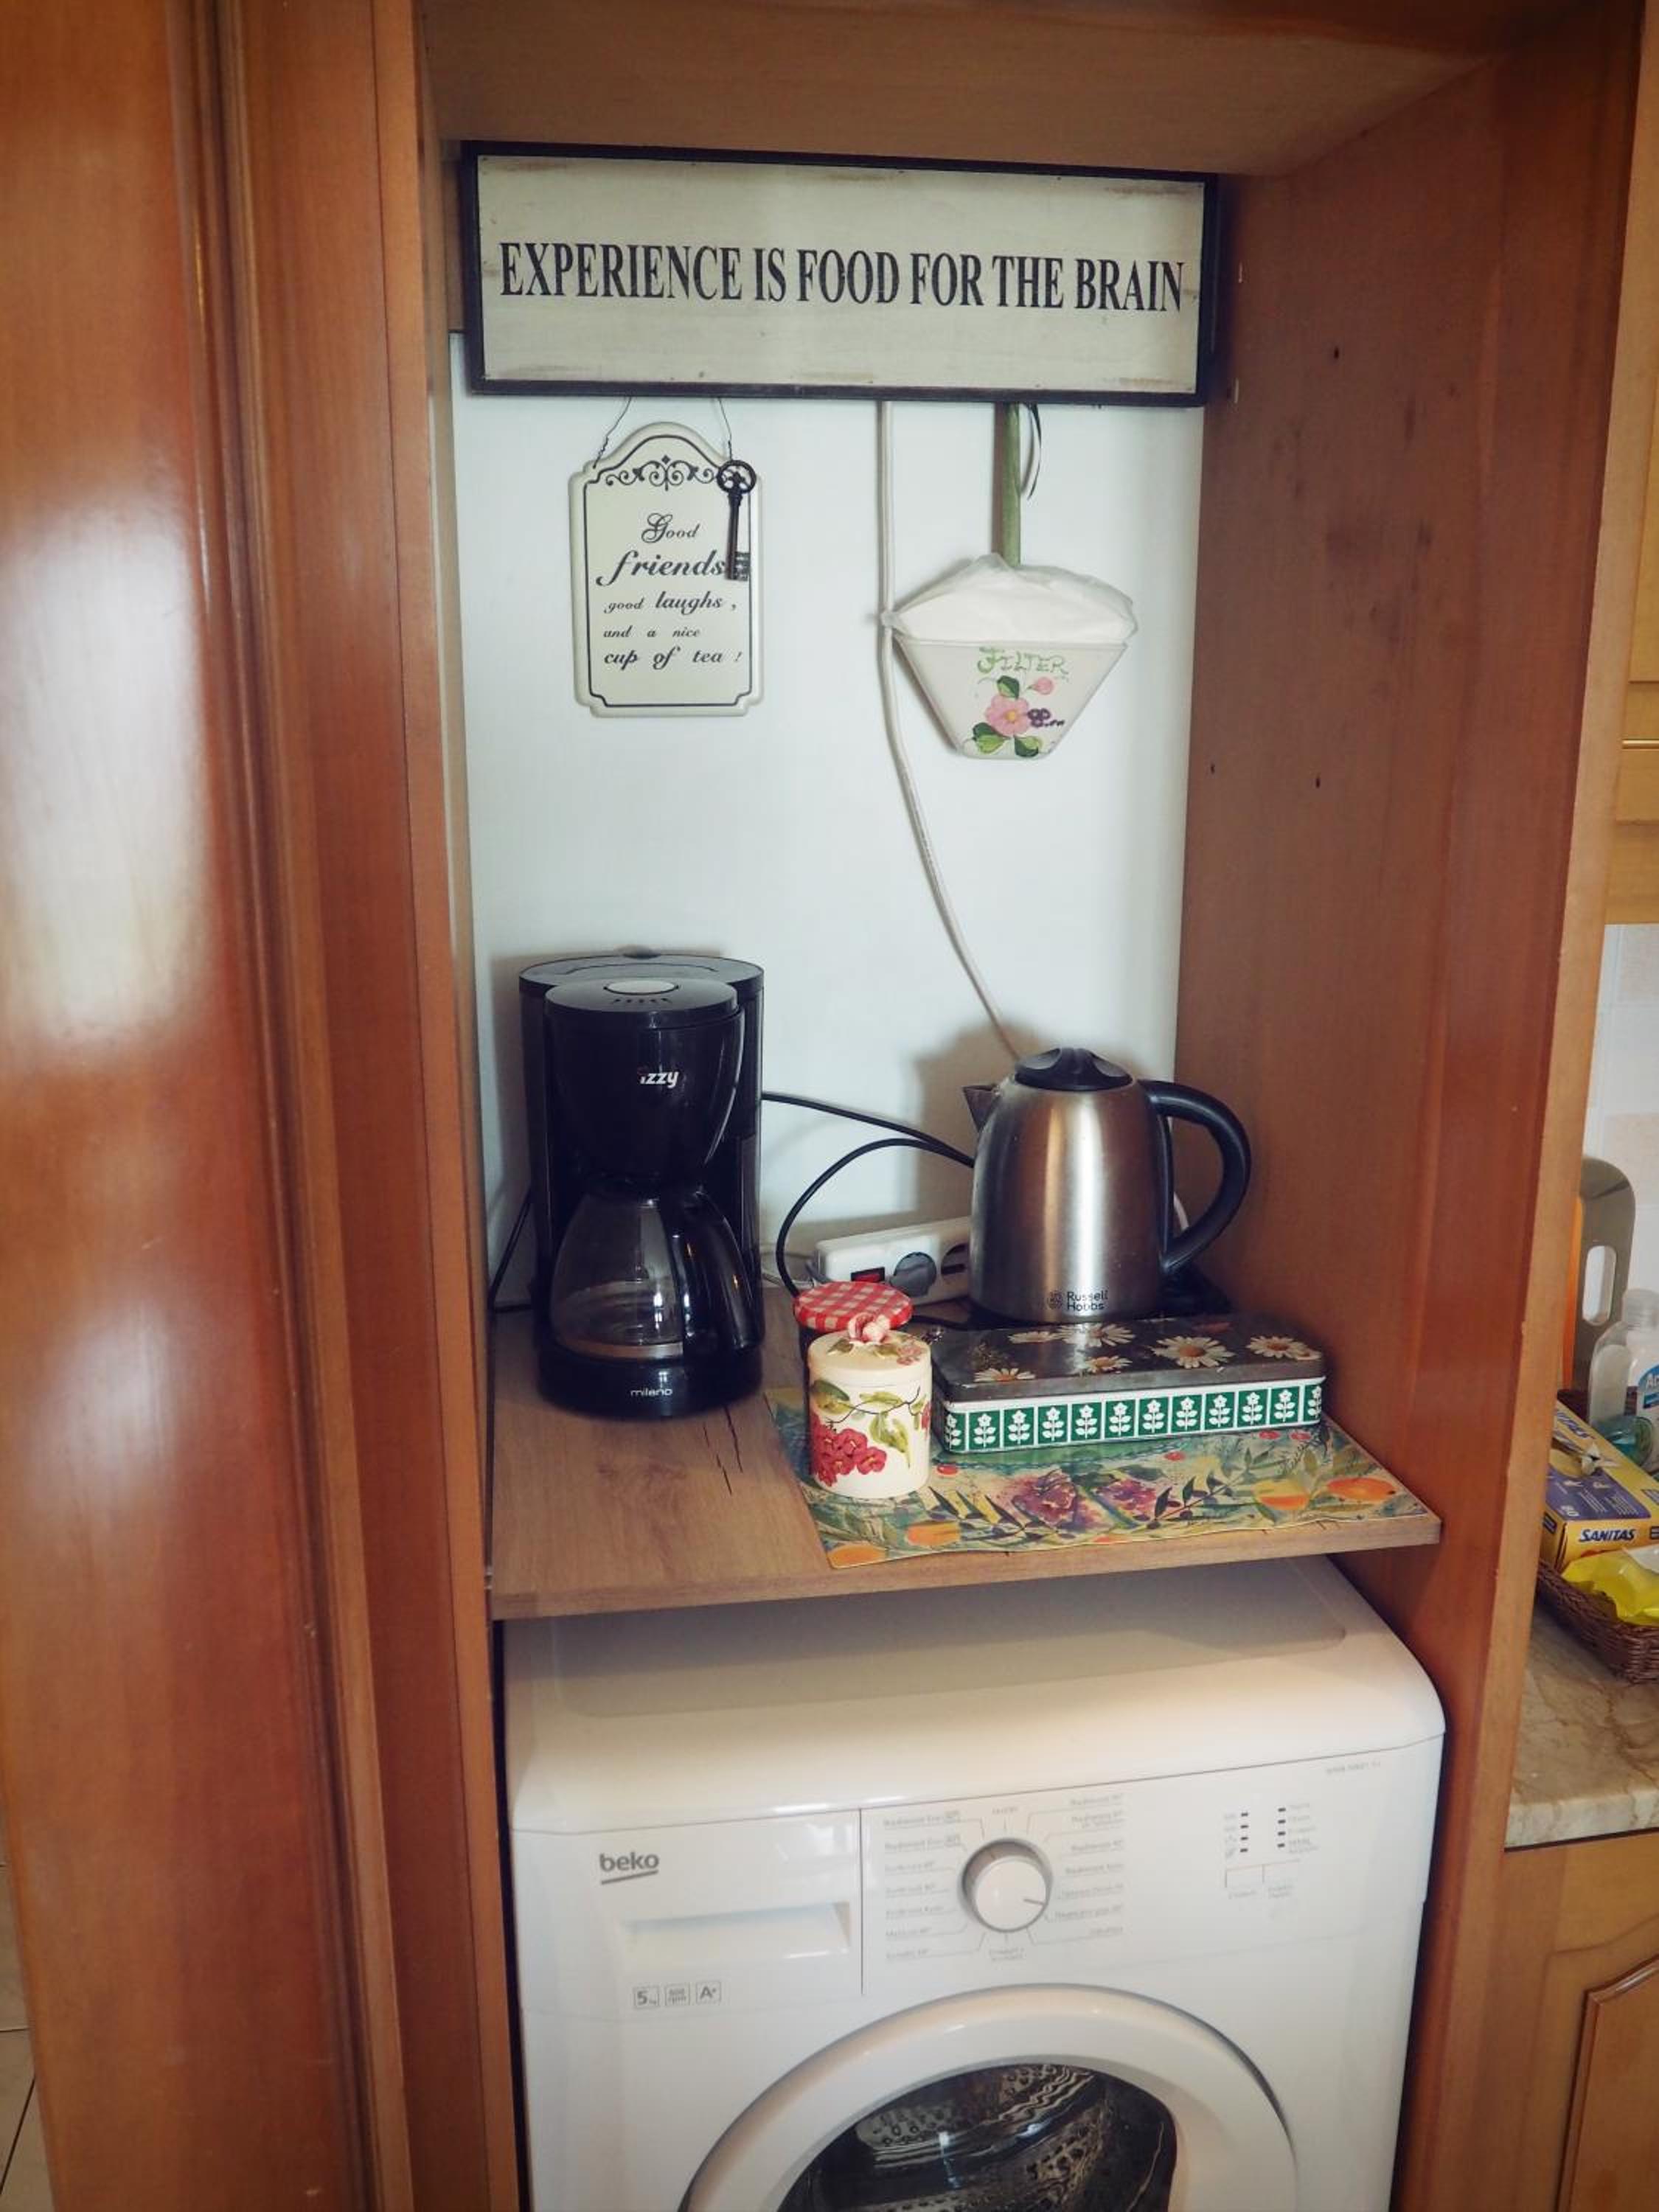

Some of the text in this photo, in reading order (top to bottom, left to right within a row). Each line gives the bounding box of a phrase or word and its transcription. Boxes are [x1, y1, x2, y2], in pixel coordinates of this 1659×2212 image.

[499, 242, 1184, 313] EXPERIENCE IS FOOD FOR THE BRAIN
[641, 512, 700, 543] Good
[596, 549, 725, 587] friends
[604, 597, 644, 614] good
[603, 625, 700, 638] and a nice
[603, 650, 639, 670] cup
[653, 646, 682, 670] of
[1066, 1290, 1108, 1302] Russell
[1580, 1528, 1635, 1543] SANITAS
[599, 1851, 660, 1873] beko
